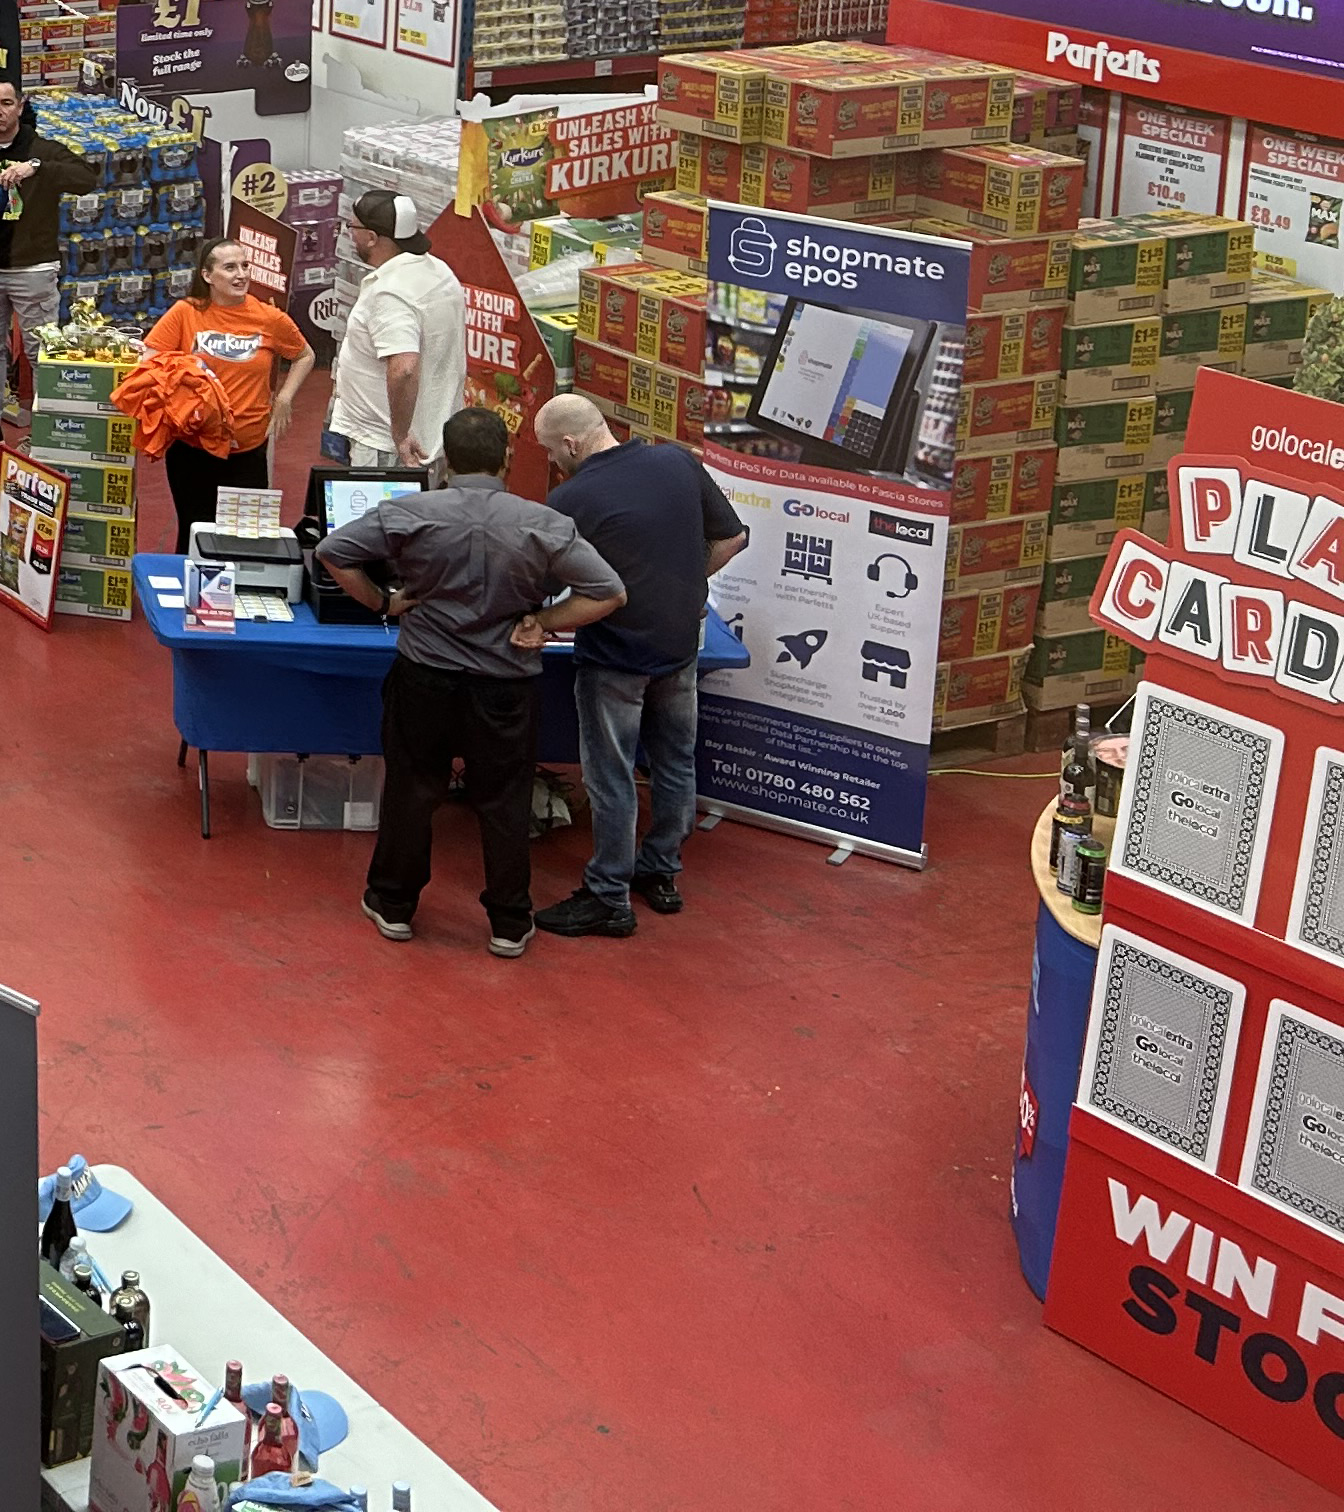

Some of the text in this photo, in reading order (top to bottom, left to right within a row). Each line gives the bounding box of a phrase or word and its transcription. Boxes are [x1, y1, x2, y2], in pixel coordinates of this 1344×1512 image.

[153, 49, 200, 64] Stock the
[153, 59, 202, 77] full range
[1046, 31, 1161, 83] Parfetts
[555, 106, 637, 141] UNLEASH
[1137, 110, 1215, 137] ONE WEEK
[1142, 125, 1207, 147] SPECIAL!
[568, 131, 623, 158] SALES
[1267, 151, 1338, 177] SPECIAL!
[242, 171, 275, 196] #2
[1147, 182, 1186, 203] £10.49
[1250, 205, 1291, 230] £8.49
[239, 226, 277, 254] UNLEASH
[786, 235, 945, 280] shopmate
[784, 261, 858, 289] epos
[473, 293, 515, 317] YOUR
[762, 465, 777, 477] for
[780, 469, 806, 482] Data
[808, 475, 857, 492] available
[859, 483, 870, 492] to
[872, 485, 905, 502] Fascia
[907, 494, 944, 508] Stores
[875, 604, 904, 618] Expert
[793, 724, 817, 736] good
[819, 730, 862, 747] suppliers
[864, 740, 874, 750] to
[876, 745, 902, 758] other
[712, 758, 871, 811] Tel: 01780 480 562
[712, 774, 869, 824] www.shopmate.co.uk
[1106, 1176, 1277, 1319] WIN
